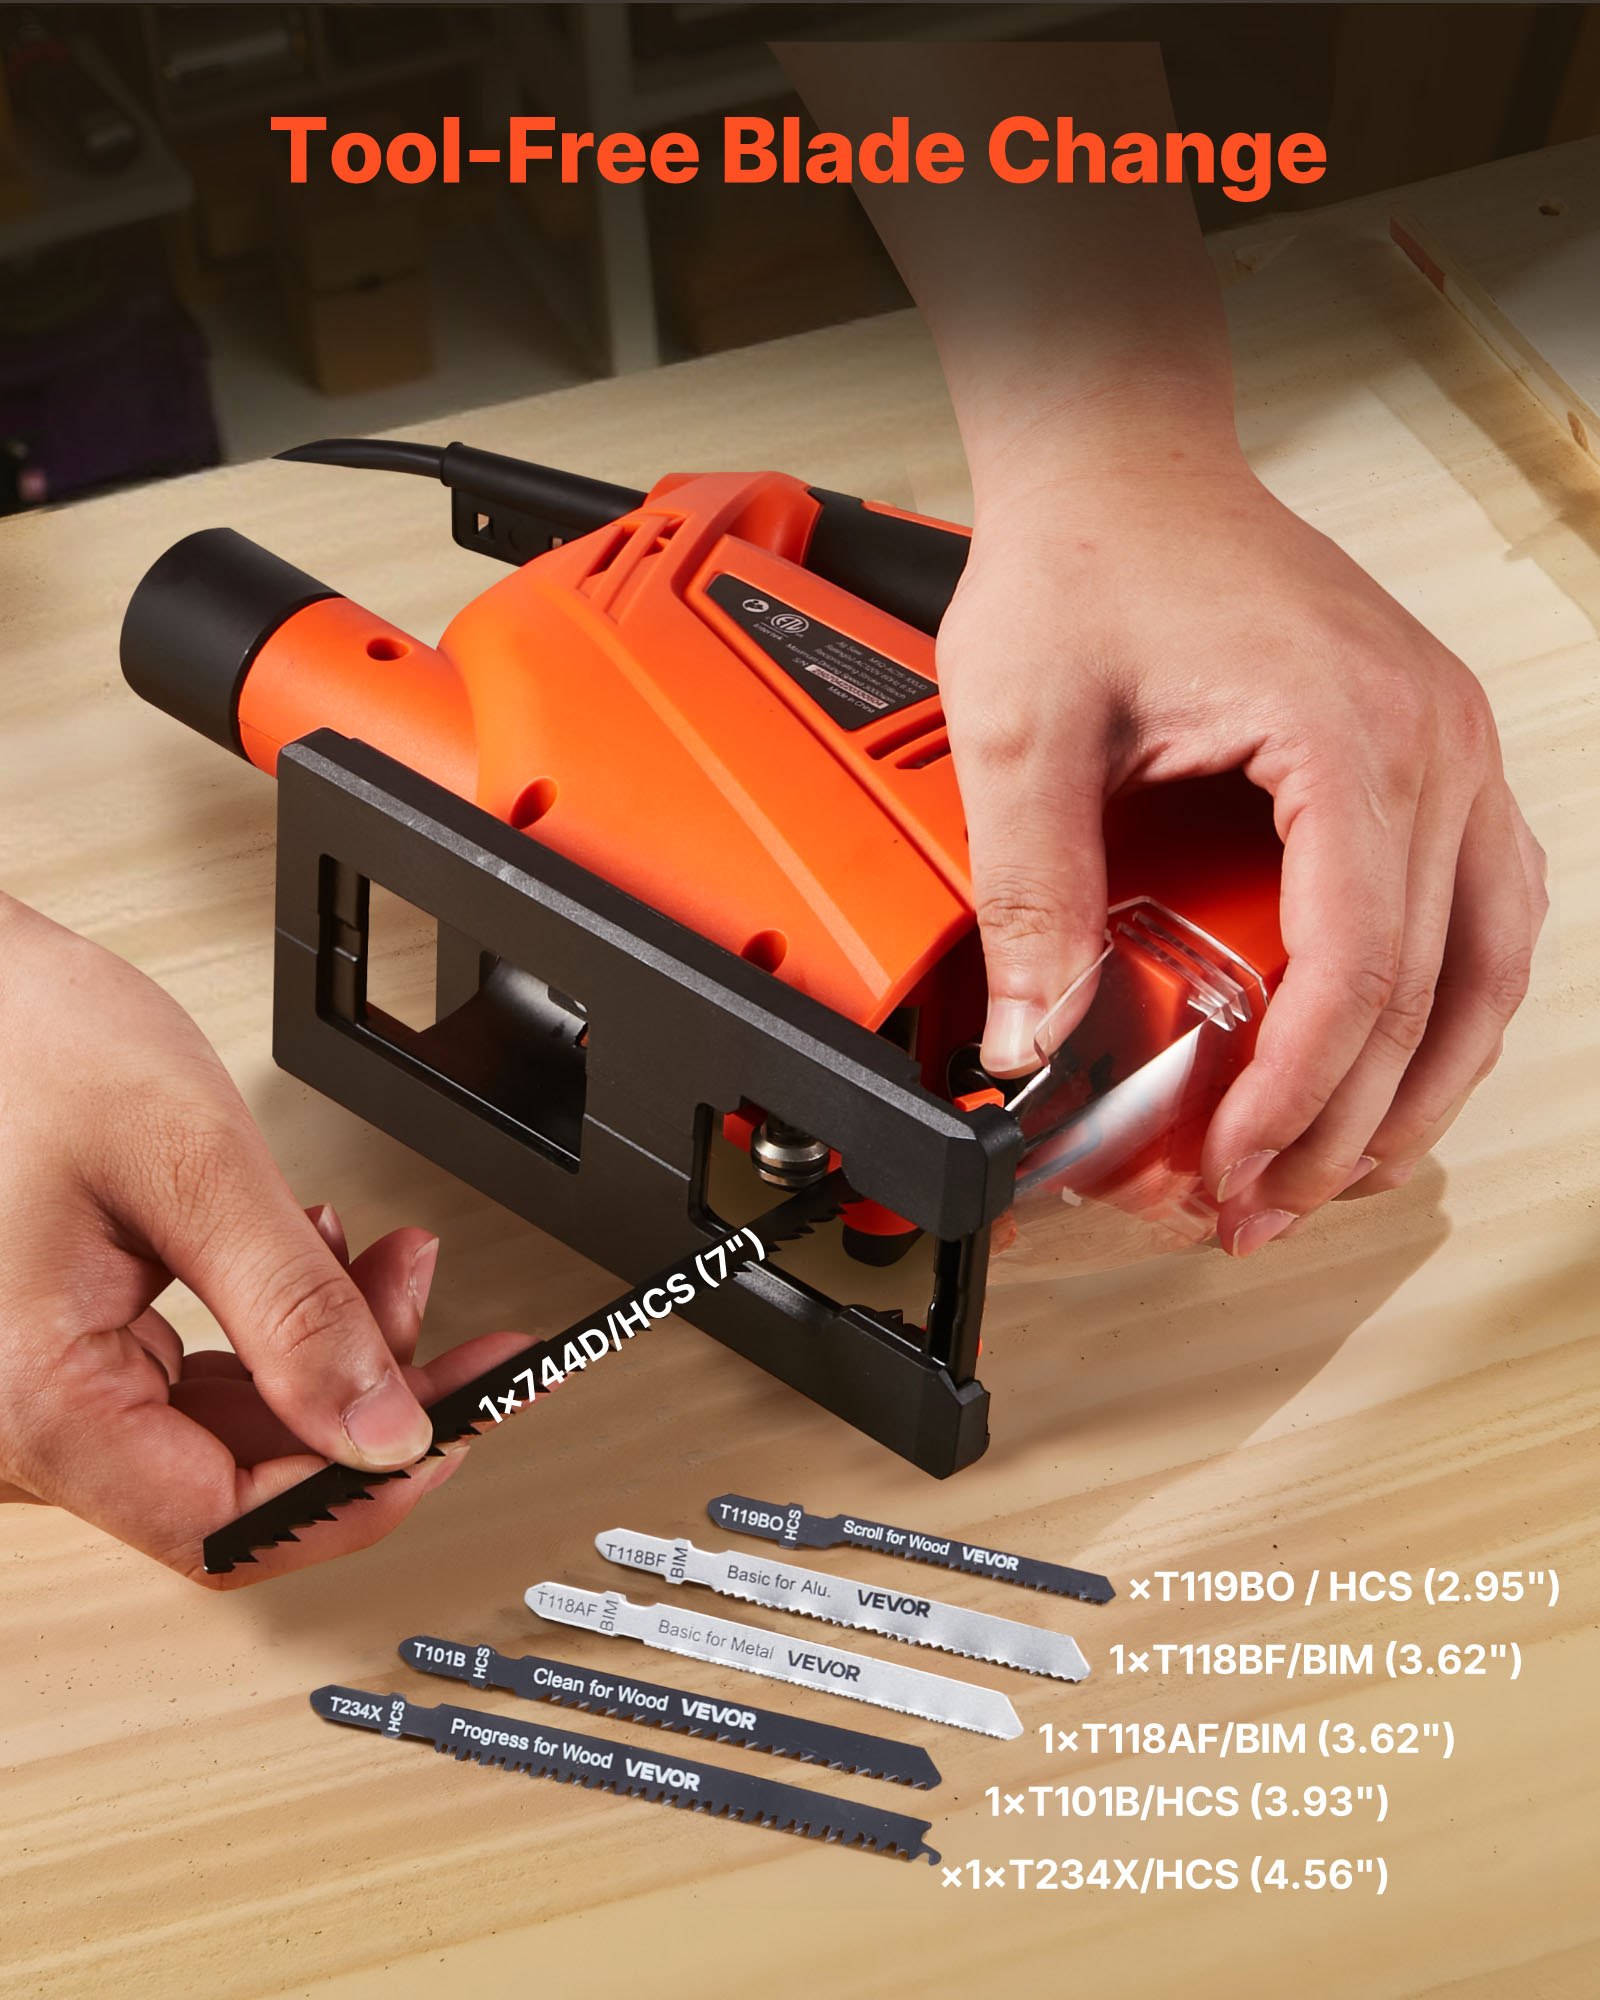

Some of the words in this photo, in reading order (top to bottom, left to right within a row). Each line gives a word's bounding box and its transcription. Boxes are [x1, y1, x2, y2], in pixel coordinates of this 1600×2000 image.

[719, 1503, 784, 1532] T119BO
[784, 1508, 802, 1541] HCS
[605, 1543, 667, 1568] T118BF
[843, 1519, 884, 1542] Scroll
[885, 1528, 907, 1546] for
[908, 1534, 950, 1556] Wood
[961, 1546, 1019, 1571] VEVOR
[671, 1546, 688, 1579] BIM
[537, 1590, 597, 1617] T118AF
[727, 1564, 771, 1588] Basic
[774, 1573, 797, 1591] for
[800, 1578, 832, 1598] Alu.
[856, 1589, 931, 1618] VEVOR
[600, 1598, 619, 1632] BIM
[413, 1641, 467, 1668] T101B
[472, 1647, 491, 1680] HCS
[658, 1618, 701, 1643] Basic
[705, 1629, 728, 1648] for
[730, 1635, 774, 1660] Metal
[787, 1649, 861, 1682] VEVOR
[329, 1696, 383, 1723] T234X
[386, 1699, 406, 1733] HCS
[533, 1667, 585, 1694] Clean
[588, 1679, 614, 1700] for
[617, 1686, 670, 1712] Wood
[681, 1697, 758, 1732] VEVOR
[450, 1717, 530, 1752] Progress
[533, 1735, 560, 1757] for
[561, 1743, 614, 1770] Wood
[624, 1757, 700, 1793] VEVOR
